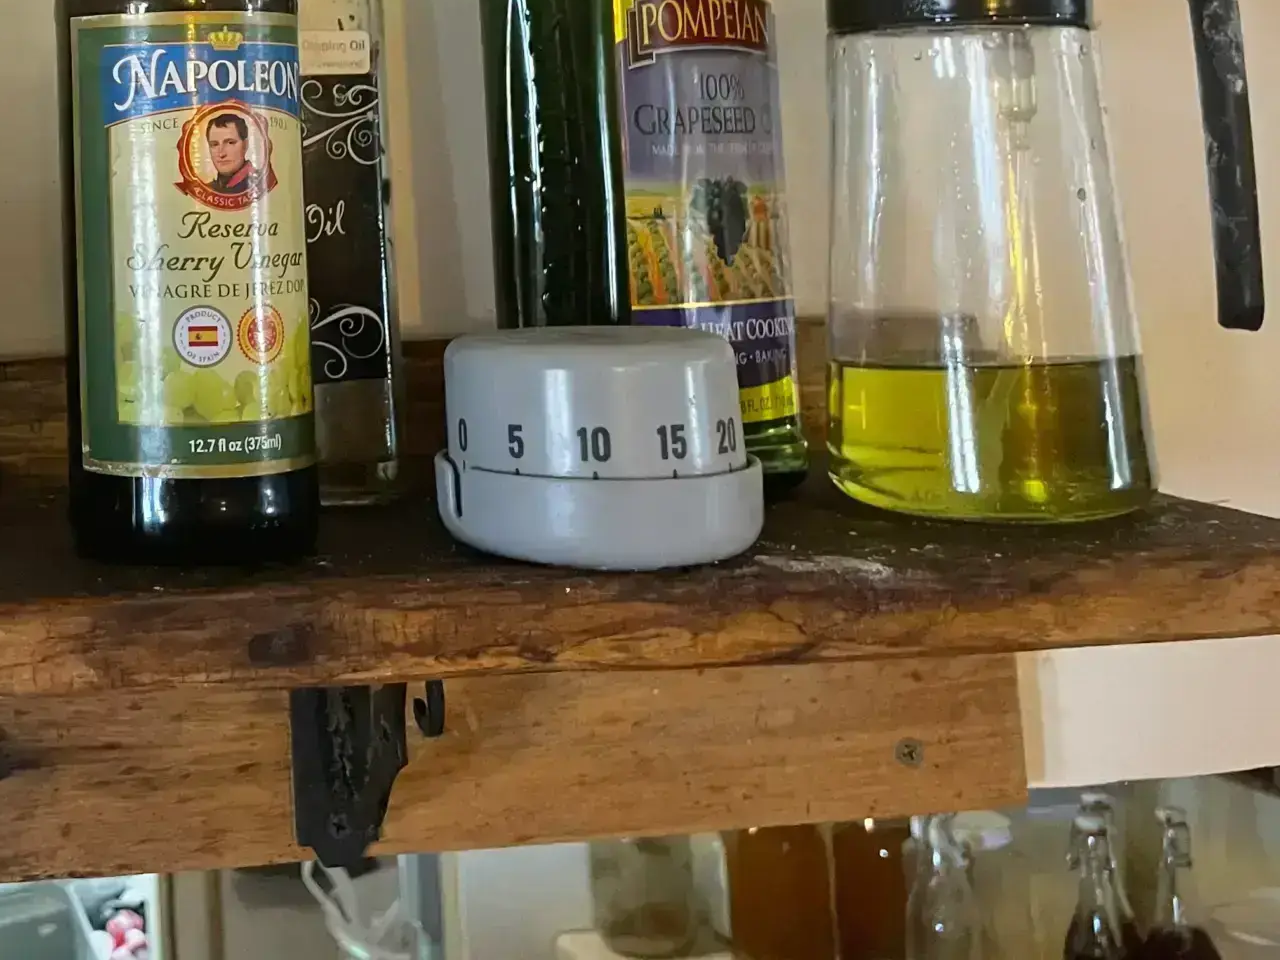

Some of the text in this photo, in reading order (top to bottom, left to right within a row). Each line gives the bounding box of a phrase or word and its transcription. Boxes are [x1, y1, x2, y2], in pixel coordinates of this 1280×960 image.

[350, 40, 365, 51] Oil
[113, 49, 299, 111] NAPOLEON
[700, 72, 744, 101] 100%
[141, 118, 179, 134] SINCE
[633, 104, 756, 135] GRAPESEED
[197, 189, 234, 206] CLASSIC
[178, 211, 278, 240] Reserva
[126, 243, 225, 283] Sherry
[218, 283, 240, 299] DE
[185, 310, 221, 323] PRODUCT
[199, 351, 220, 363] SPAIN
[188, 434, 282, 454] 12.7 fl oz (375ml)
[459, 417, 737, 463] 0 5 10 15 20
